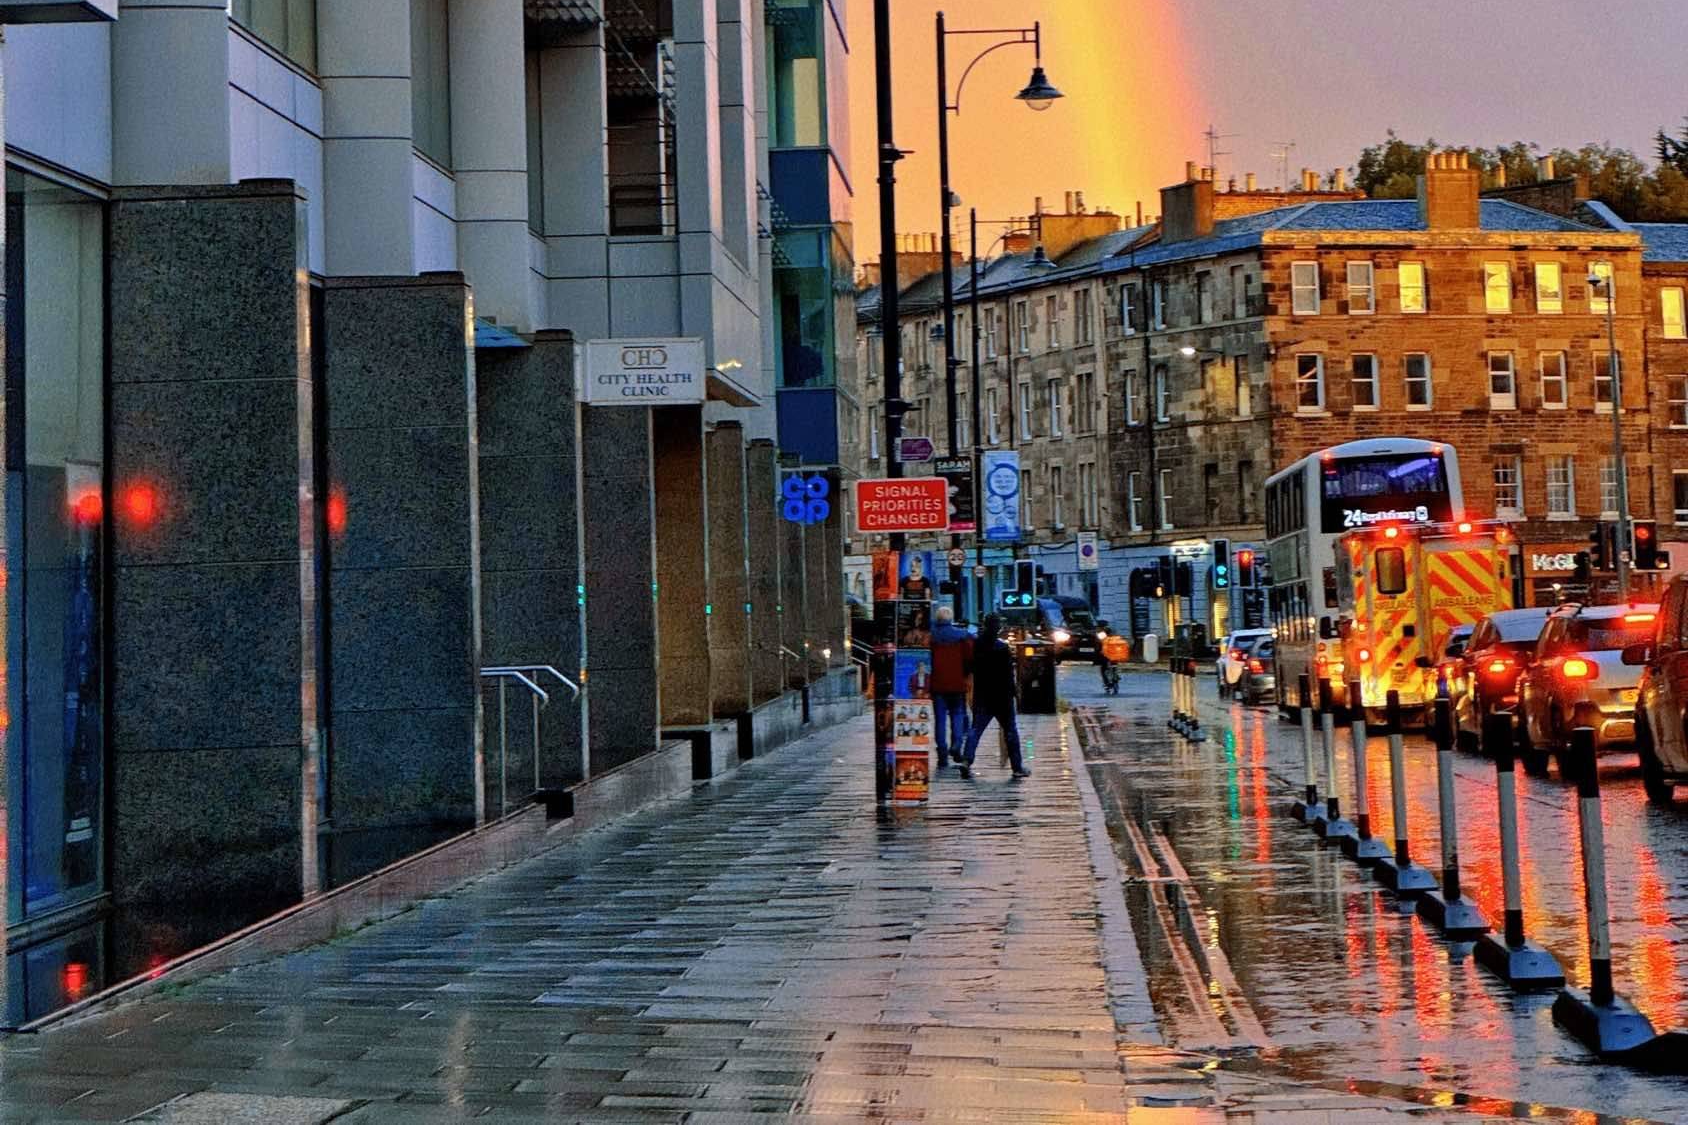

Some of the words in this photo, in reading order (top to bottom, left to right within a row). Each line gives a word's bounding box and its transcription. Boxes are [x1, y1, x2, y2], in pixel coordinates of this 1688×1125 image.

[598, 374, 631, 386] CITY
[636, 373, 692, 385] HEALTH
[621, 386, 670, 397] CLINIC
[875, 485, 929, 498] SIGNAL
[863, 498, 942, 512] PRIORITIES
[866, 513, 939, 525] CHANGED
[1343, 510, 1362, 527] 24
